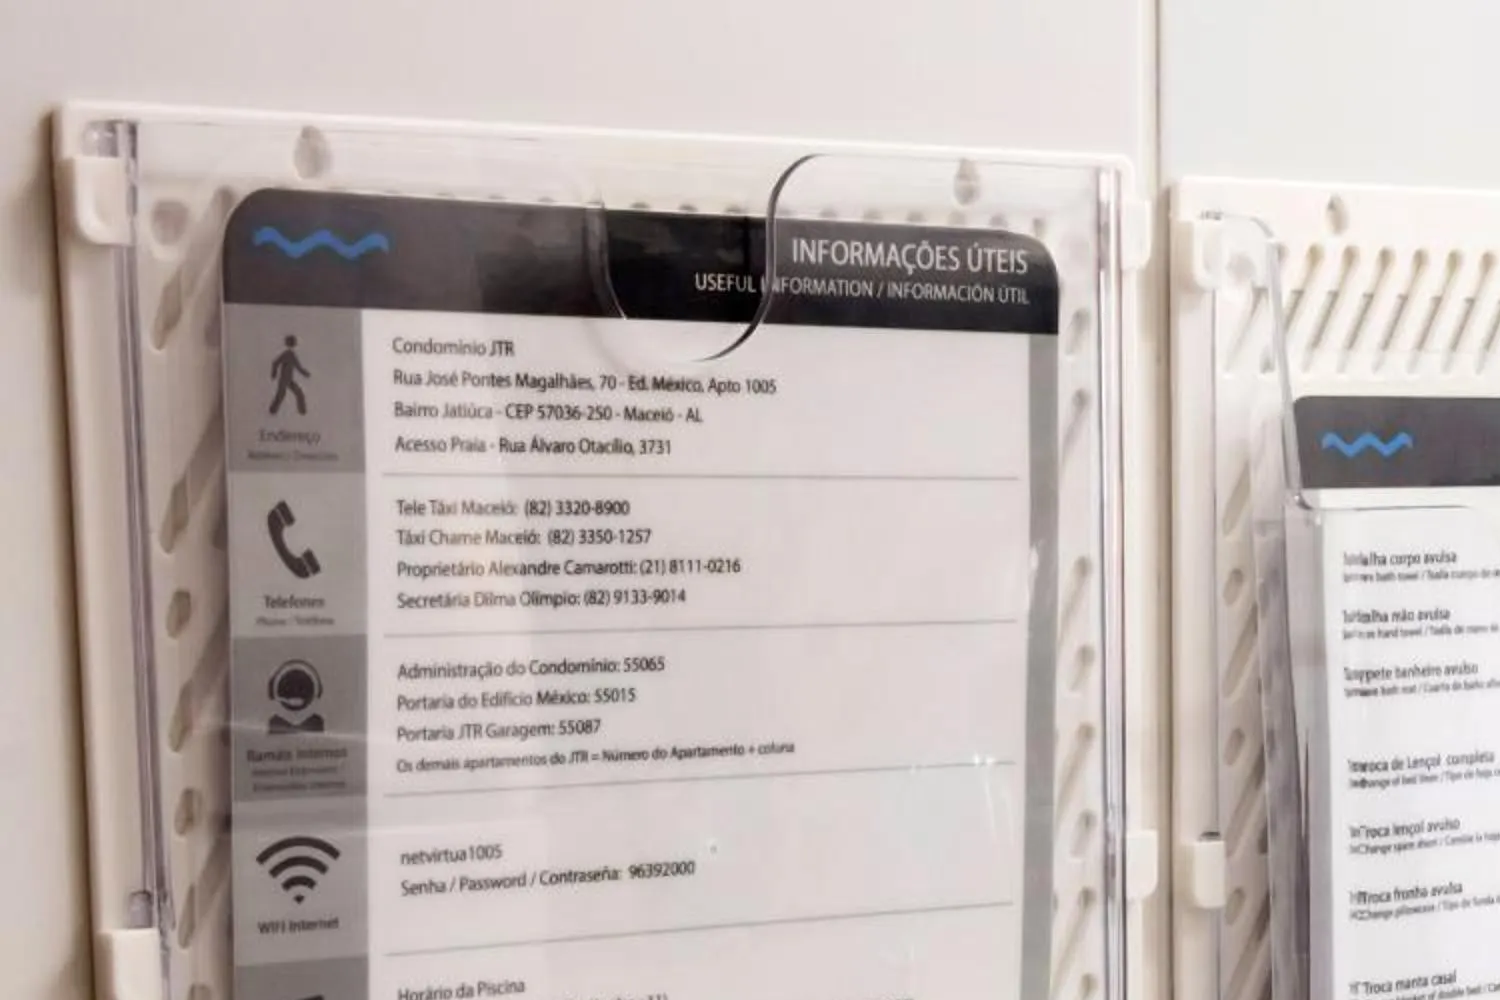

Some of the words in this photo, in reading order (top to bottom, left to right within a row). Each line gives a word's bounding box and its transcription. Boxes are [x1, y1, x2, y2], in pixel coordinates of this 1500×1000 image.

[792, 238, 960, 275] INFORMAÇÕES
[967, 242, 1028, 275] ÚTEIS
[695, 273, 756, 293] USEFUL
[887, 281, 994, 303] INFORMACIÓN
[998, 284, 1029, 304] ÚTIL
[489, 340, 515, 357] JTR
[393, 368, 423, 386] Rua
[425, 370, 458, 387] José
[461, 370, 512, 388] Pontes
[600, 374, 617, 391] 70
[628, 374, 652, 391] Ed.
[707, 377, 741, 397] Apto
[746, 379, 776, 395] 1005
[394, 401, 439, 418] Bairro
[505, 403, 534, 420] CEP
[537, 404, 613, 421] 57036-250
[623, 406, 675, 422] Maceió
[685, 408, 703, 423] AL
[395, 436, 448, 453] Acesso
[450, 436, 487, 453] Praia
[499, 437, 526, 453] Rua
[529, 435, 576, 454] Álvaro
[639, 439, 671, 455] 3731
[396, 499, 426, 516] Tele
[429, 499, 458, 516] Táxi
[461, 500, 518, 516] Maceió:
[524, 499, 552, 517] (82)
[556, 500, 630, 516] 3320-8900
[396, 529, 426, 546] Táxi
[428, 528, 482, 546] Chame
[485, 529, 541, 545] Maceió:
[547, 529, 575, 546] (82)
[579, 528, 652, 544] 3350-1257
[397, 560, 485, 580] Proprietário
[489, 560, 560, 576] Alexandre
[563, 559, 637, 576] Camarotti:
[639, 559, 666, 576] (21)
[669, 558, 741, 574] 8111-0216
[264, 595, 325, 609] Telefones
[397, 592, 471, 609] Secretária
[473, 591, 517, 608] Dilma
[519, 590, 581, 609] Olímpio:
[583, 589, 610, 606] (82)
[613, 588, 686, 605] 9133-9014
[397, 662, 503, 681] Administração
[505, 660, 528, 677] do
[623, 656, 665, 672] 55065
[397, 694, 455, 711] Portaria
[457, 693, 479, 709] do
[536, 690, 590, 705] México:
[594, 688, 636, 703] 55015
[396, 725, 455, 742] Portaria
[458, 723, 482, 740] JTR
[484, 723, 555, 742] Garagem:
[559, 718, 601, 735] 55087
[401, 879, 447, 896] Senha
[459, 872, 527, 892] Password
[539, 866, 621, 886] Contraseña:
[628, 860, 696, 879] 96392000
[455, 982, 475, 999] da
[477, 980, 526, 997] Piscina
[1364, 980, 1392, 994] Troca
[1396, 976, 1428, 990] manta
[1431, 969, 1456, 986] casal
